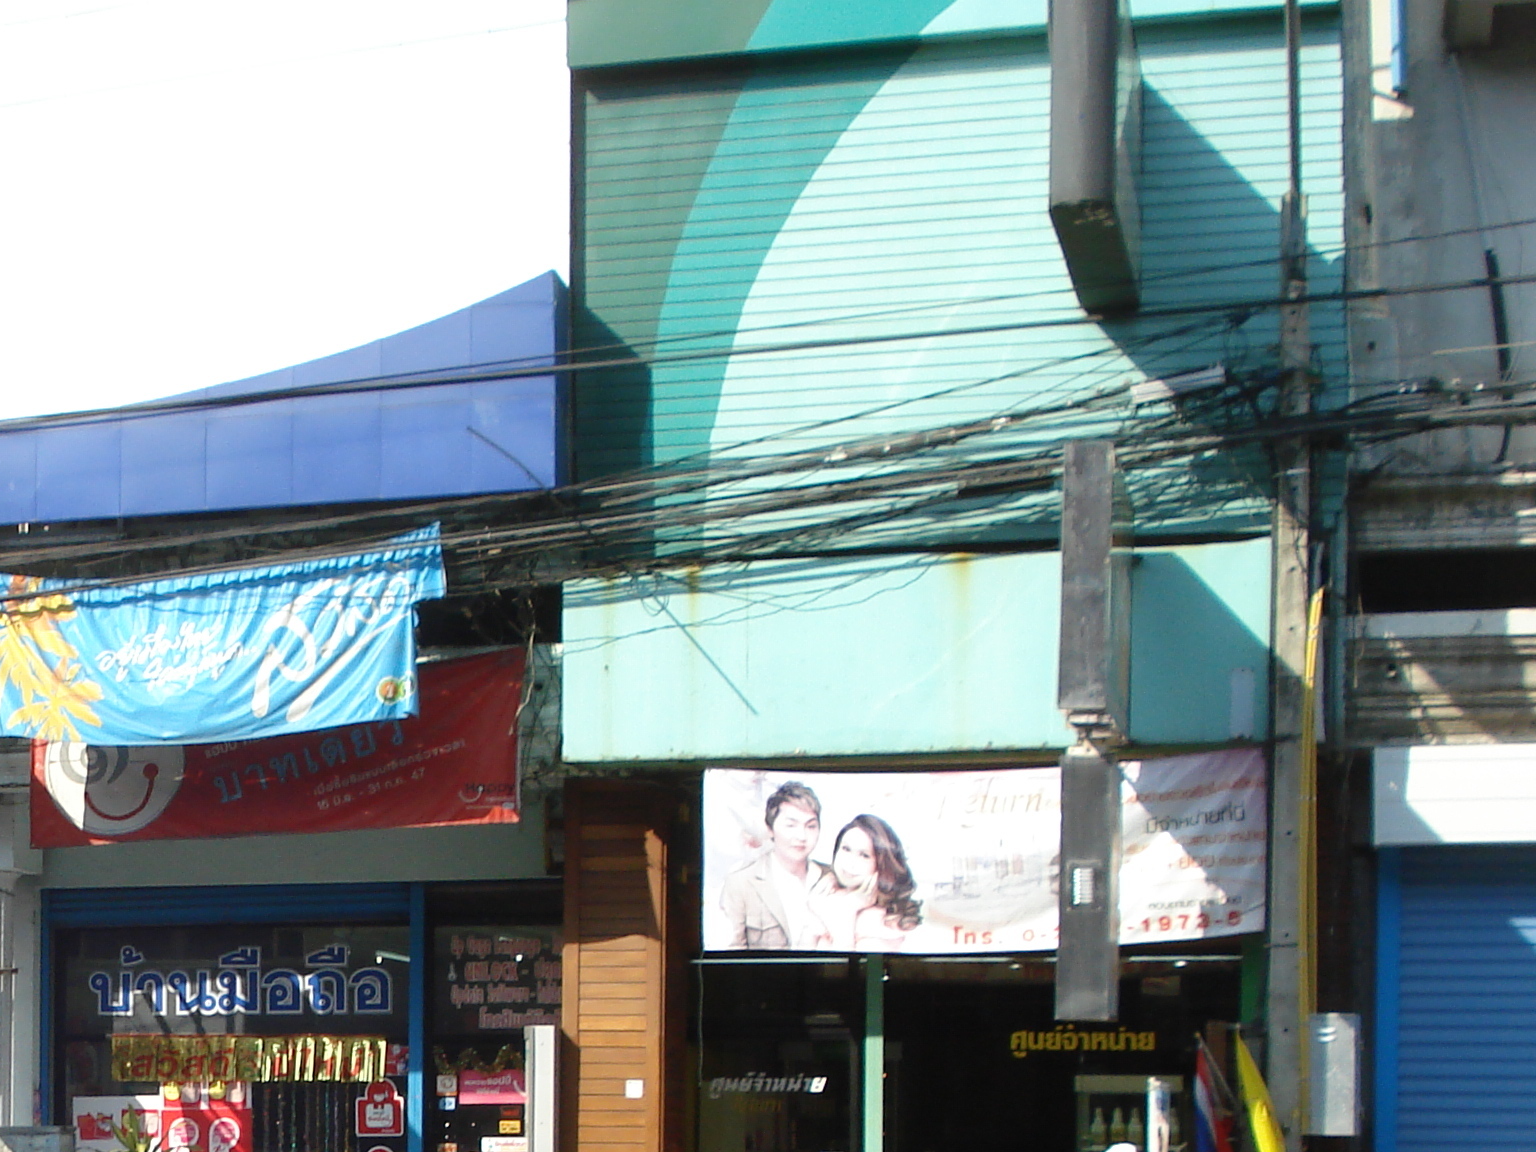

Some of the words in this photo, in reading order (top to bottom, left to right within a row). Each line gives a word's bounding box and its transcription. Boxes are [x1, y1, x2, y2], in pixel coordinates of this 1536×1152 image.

[90, 945, 393, 1016] บ้านมือถือ
[1010, 1024, 1156, 1058] ศูนย์จำหน่าย
[710, 1072, 828, 1099] ศูนย์จำหน่าย
